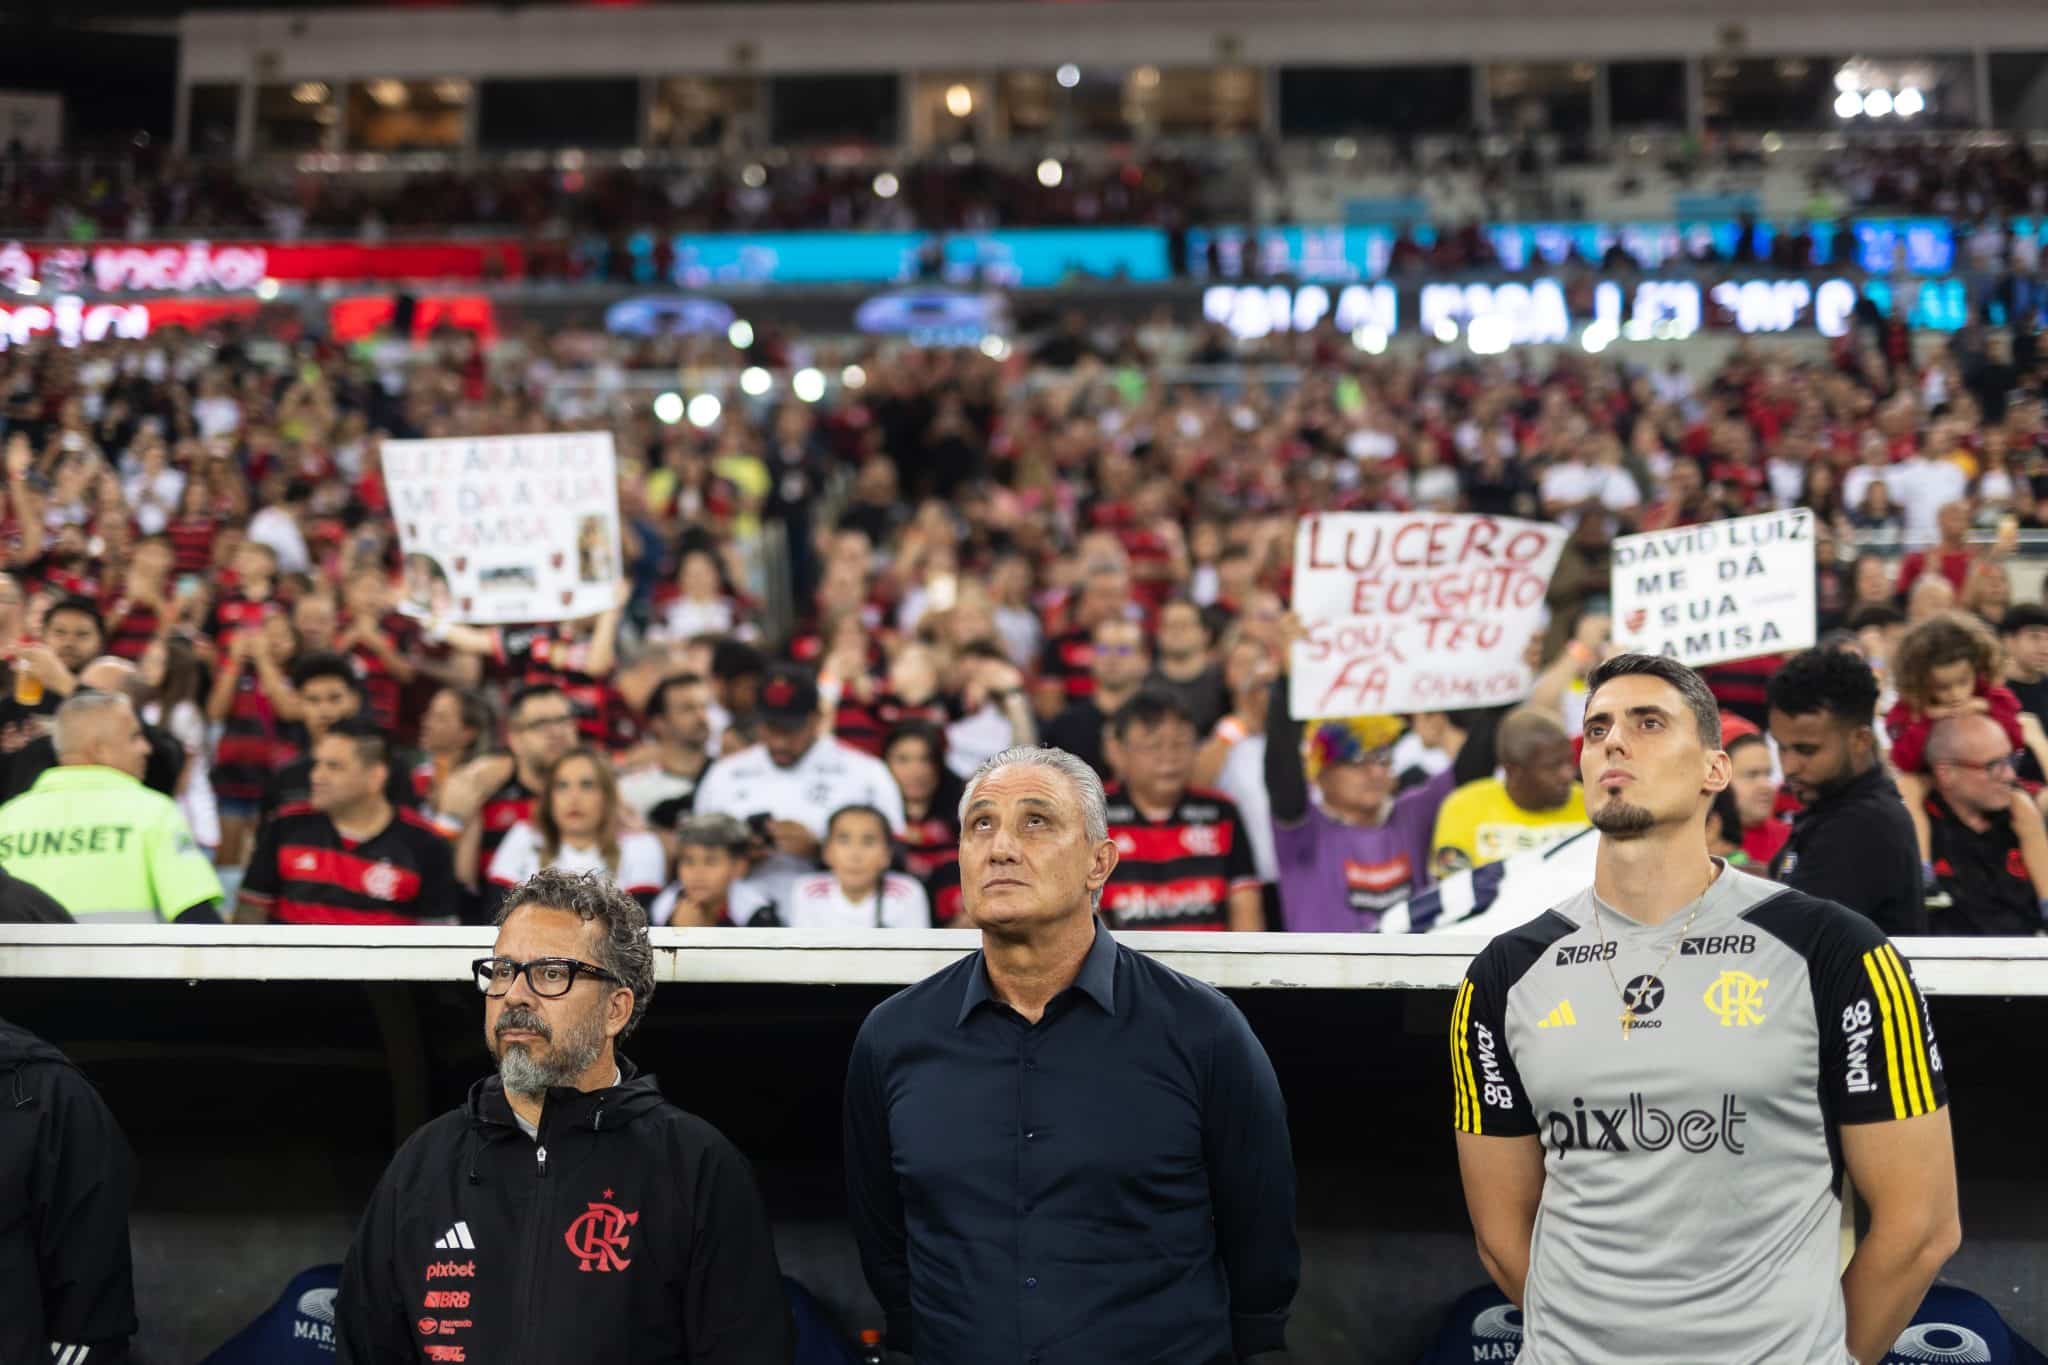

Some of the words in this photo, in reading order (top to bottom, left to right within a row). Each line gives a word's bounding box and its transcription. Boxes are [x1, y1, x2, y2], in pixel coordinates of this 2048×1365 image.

[1308, 516, 1549, 573] LUCERO
[1615, 527, 1719, 566] DAVID
[1729, 514, 1808, 545] LUIZ
[1637, 570, 1686, 594] ME
[1661, 594, 1738, 627] SUA
[1418, 616, 1504, 650] TEU
[1633, 621, 1781, 657] AMISA
[0, 826, 132, 857] SUNSET
[1575, 941, 1618, 964] BRB
[1705, 934, 1756, 955] BRB
[1474, 1021, 1504, 1082] kwai
[1845, 1028, 1878, 1093] kwai
[1547, 1092, 1747, 1160] pixbet
[426, 1260, 476, 1281] pixbet
[440, 1291, 471, 1308] BRB
